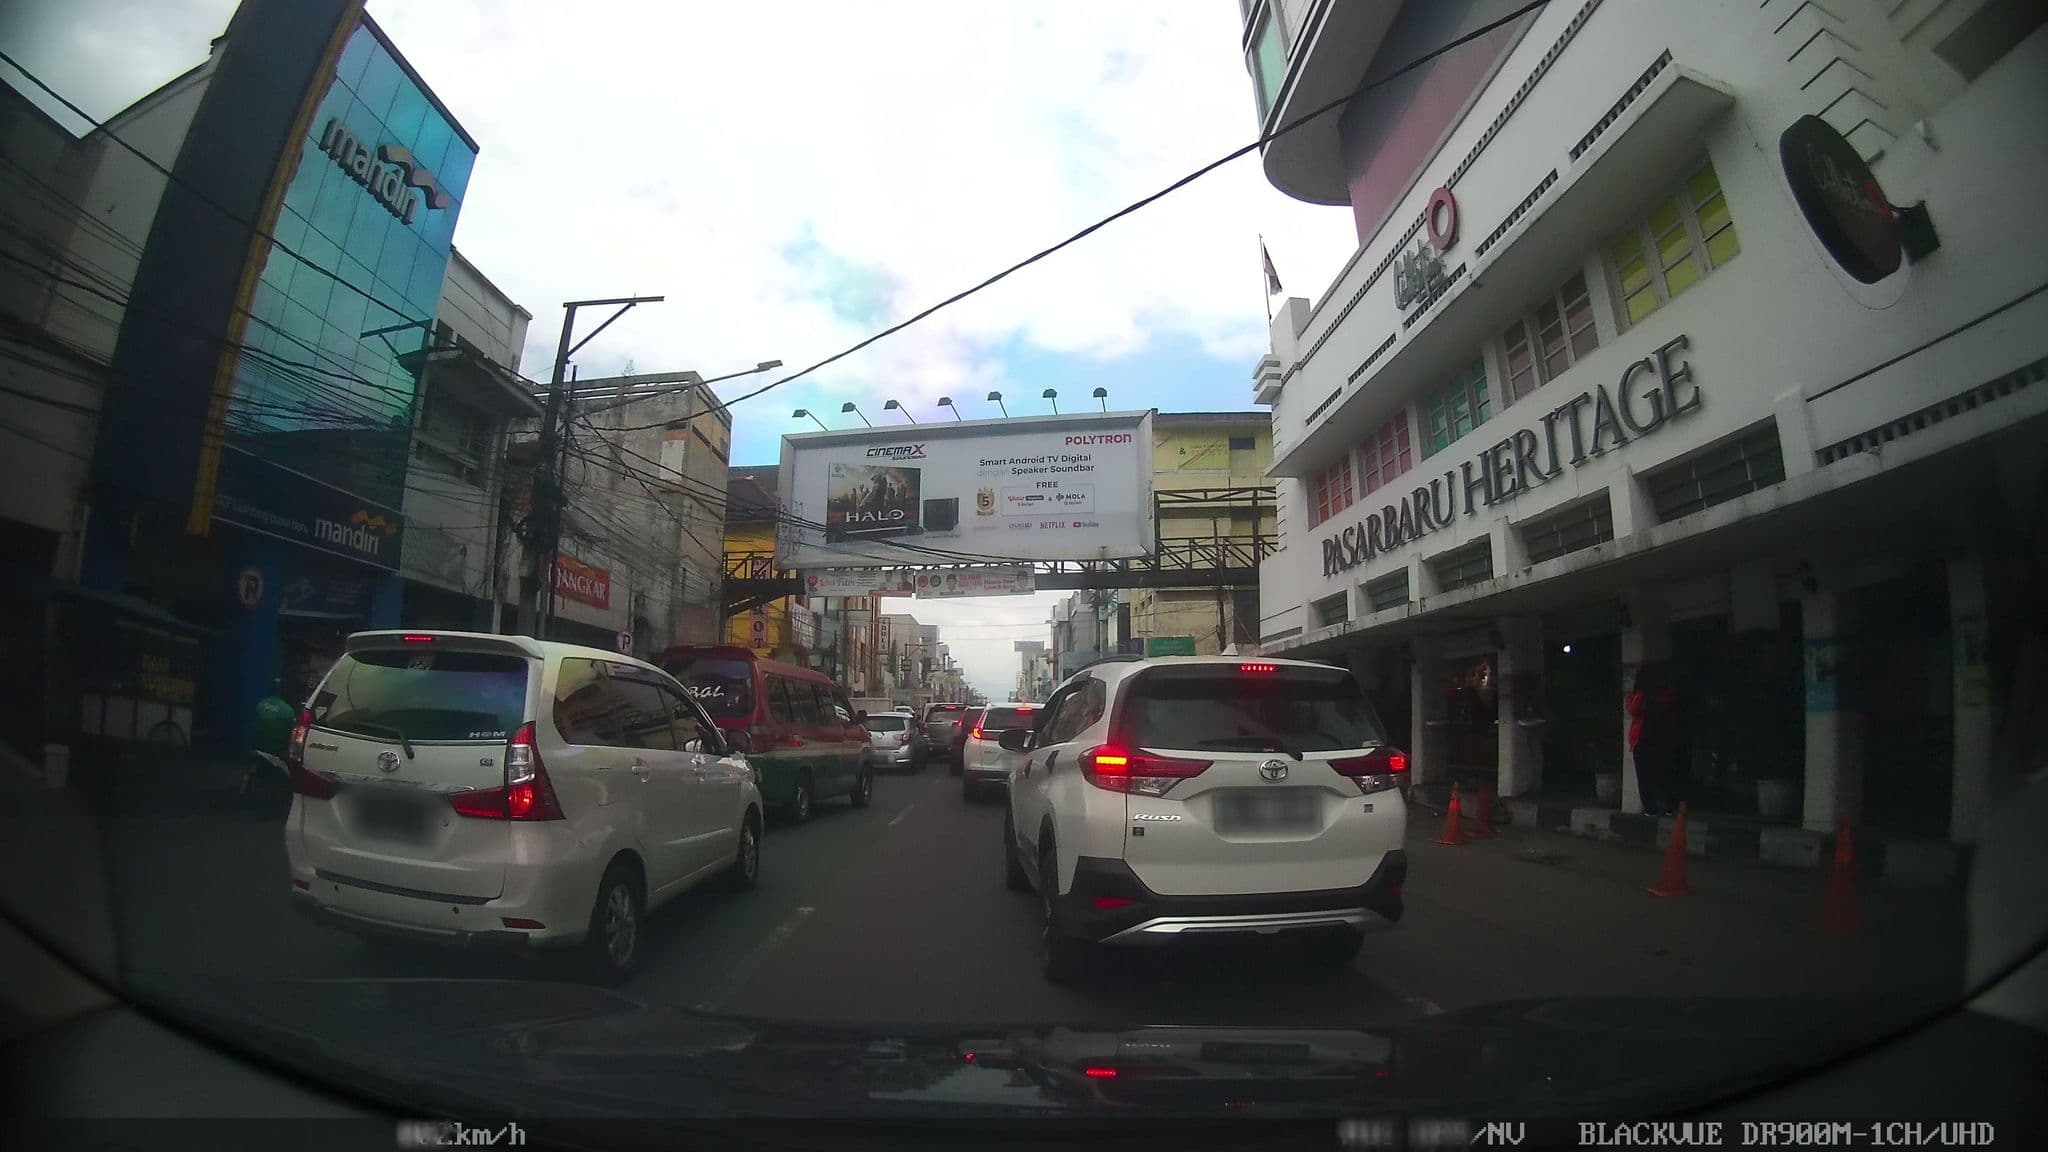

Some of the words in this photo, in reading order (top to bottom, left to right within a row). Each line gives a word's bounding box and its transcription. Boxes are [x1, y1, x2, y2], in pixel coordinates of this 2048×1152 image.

[1459, 334, 1700, 516] HERITAGE
[1065, 433, 1132, 446] POLYTRON
[979, 458, 1007, 467] Smart
[1008, 456, 1045, 465] Android
[1046, 455, 1060, 463] TV
[1061, 454, 1091, 464] Digital
[1011, 466, 1048, 476] Speaker
[1050, 464, 1095, 473] Soundbar
[1036, 481, 1059, 489] FREE
[845, 509, 904, 523] HALO
[315, 518, 379, 555] mandiri
[623, 634, 631, 650] P
[1133, 813, 1181, 821] Rush
